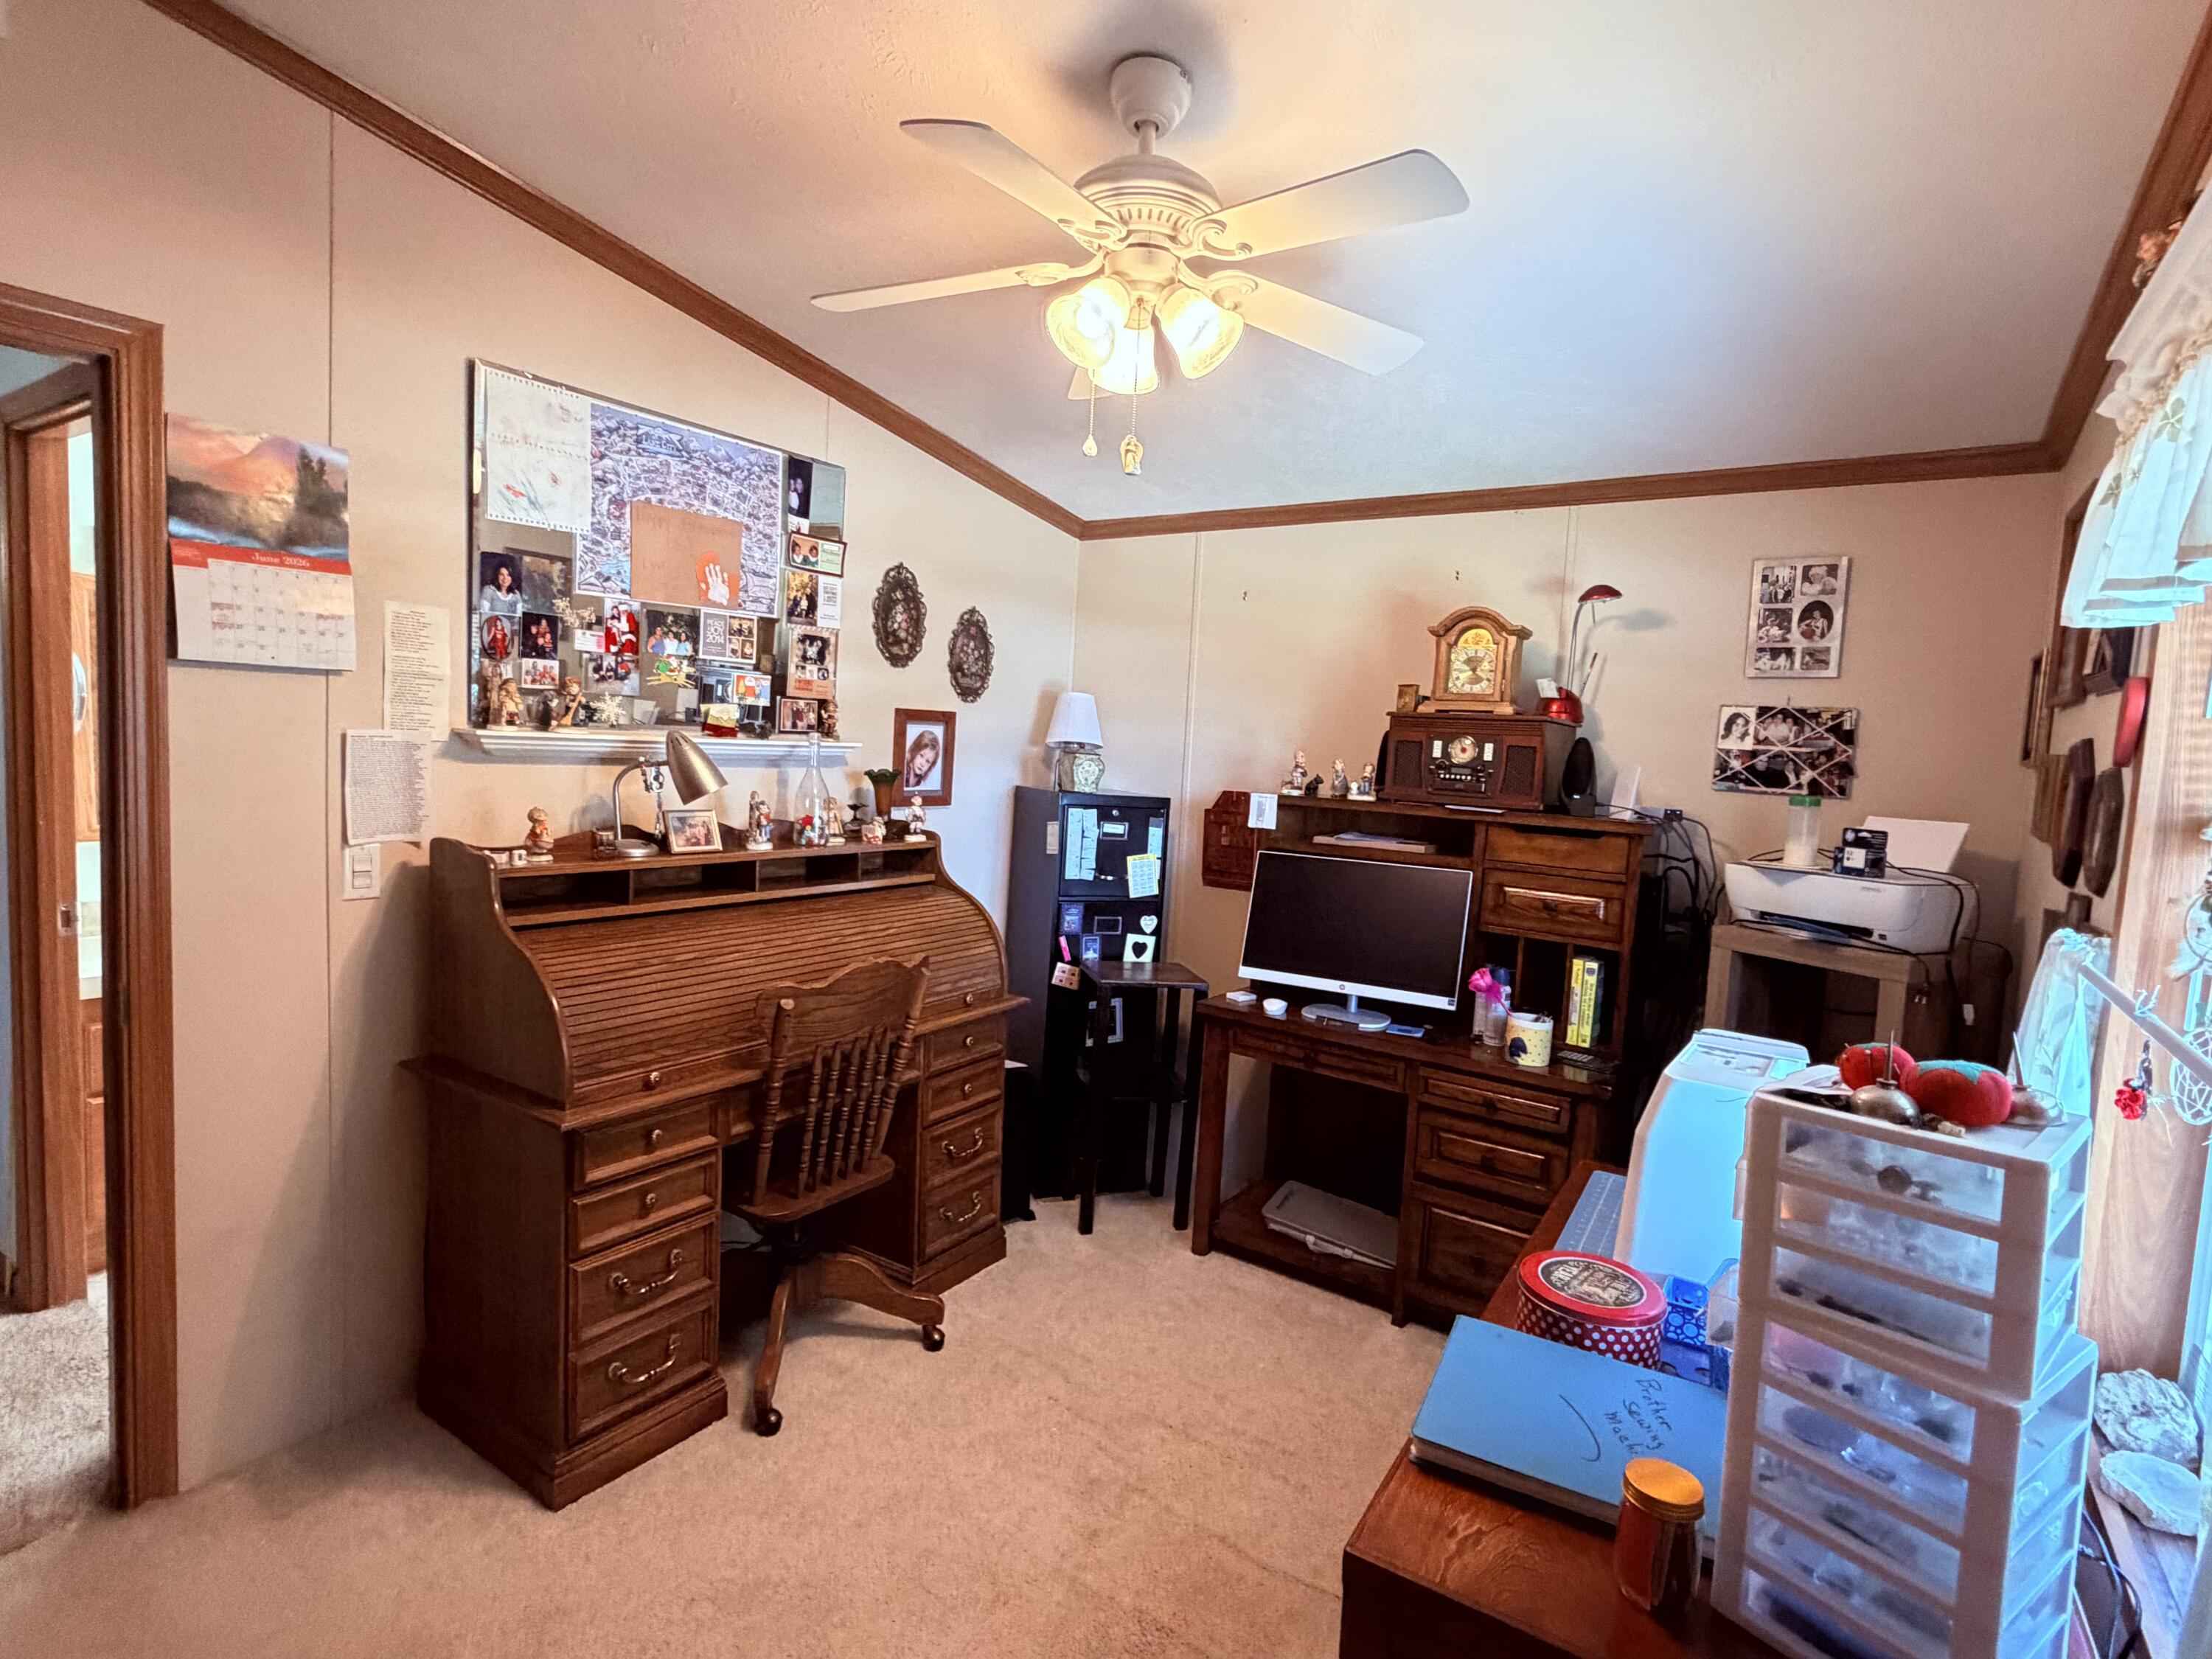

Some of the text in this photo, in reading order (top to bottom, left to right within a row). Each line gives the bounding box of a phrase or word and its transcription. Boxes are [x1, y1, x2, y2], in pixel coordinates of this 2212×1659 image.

[251, 553, 310, 568] June 2026
[1635, 1379, 1672, 1430] Brother
